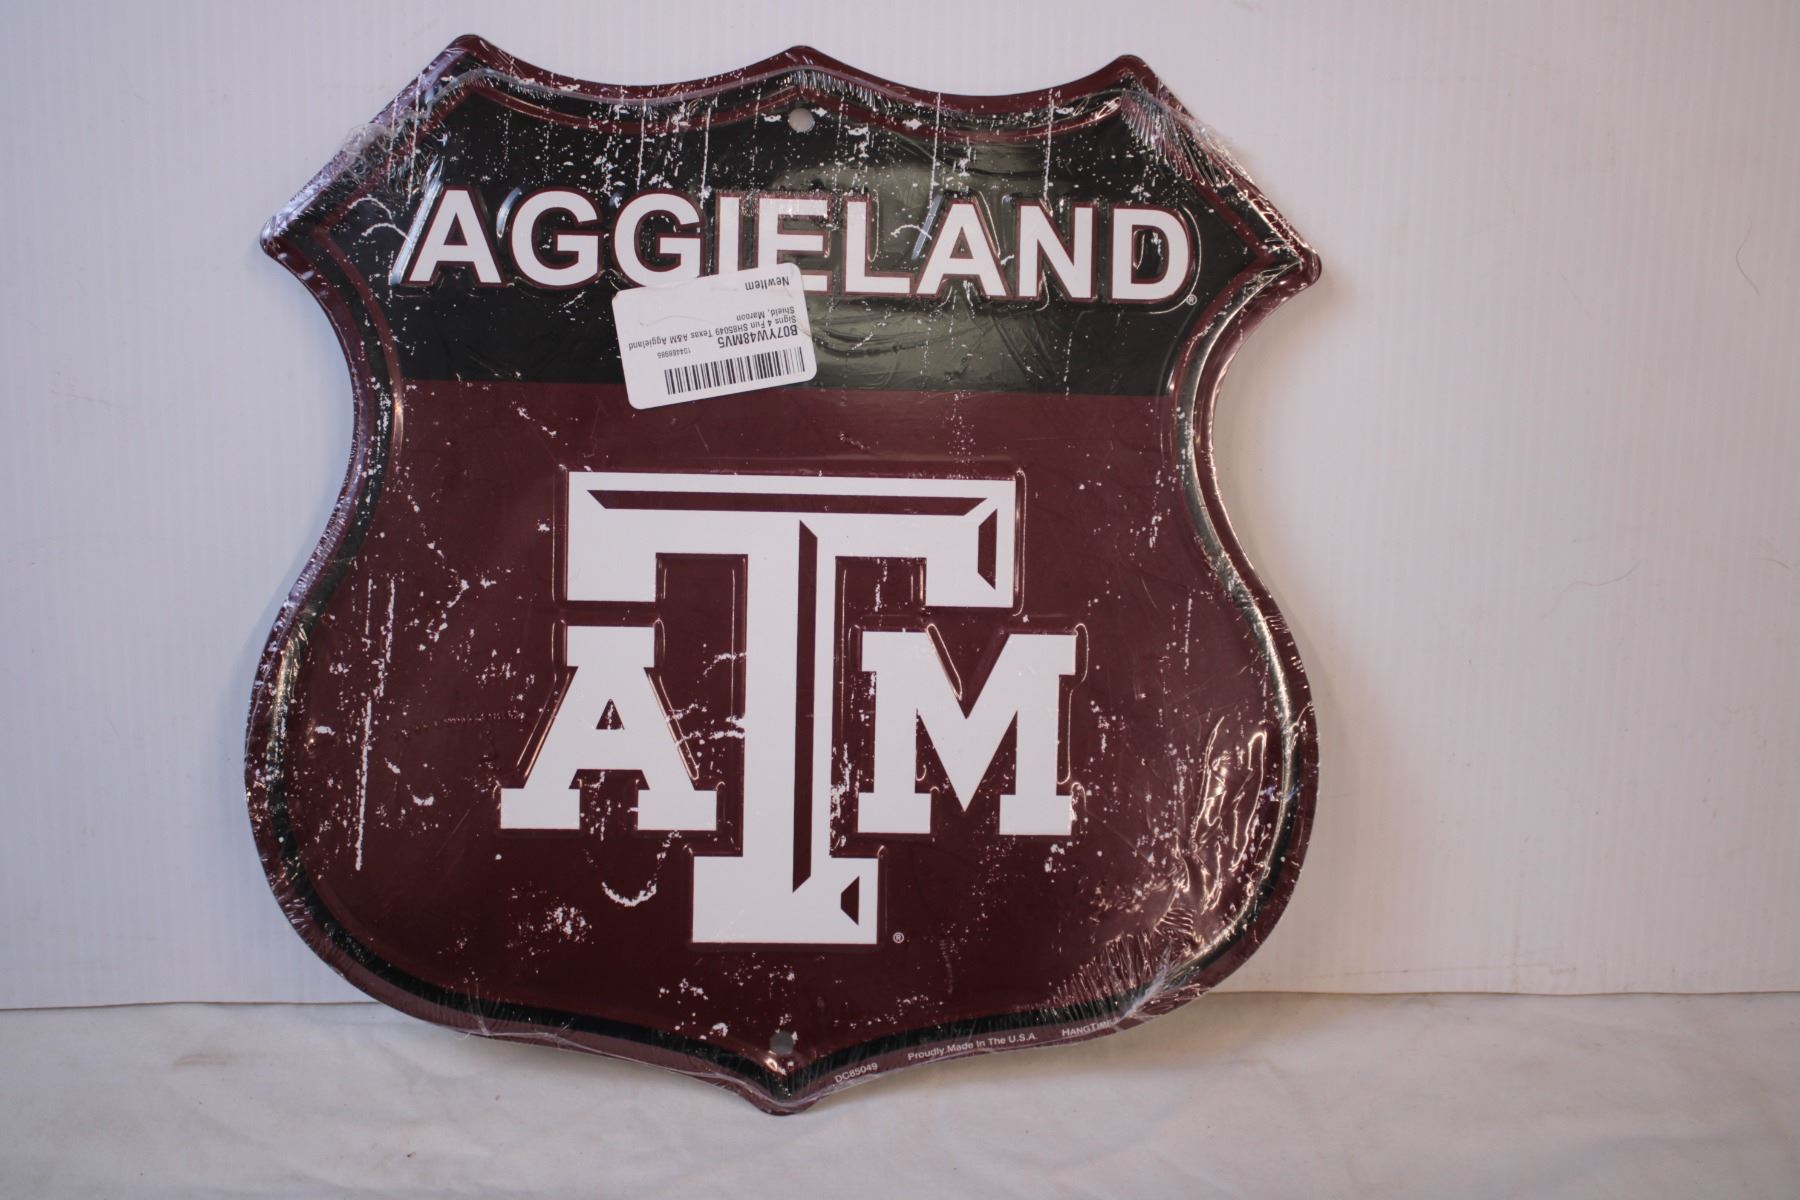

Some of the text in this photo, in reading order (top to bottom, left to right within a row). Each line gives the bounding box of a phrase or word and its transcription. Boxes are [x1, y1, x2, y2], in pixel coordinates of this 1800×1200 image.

[408, 188, 1190, 303] AGGIELAND
[744, 276, 790, 291] NewItem
[736, 311, 765, 321] Maroon
[628, 315, 797, 351] Signs 4 Fun SH85049 Texas A&M Aggieland
[717, 324, 798, 349] B07YW48MV5
[907, 1046, 945, 1061] Proudly
[946, 1041, 974, 1053] Made
[976, 1039, 986, 1048] In
[987, 1036, 1007, 1046] The
[834, 1062, 878, 1084] DC85049
